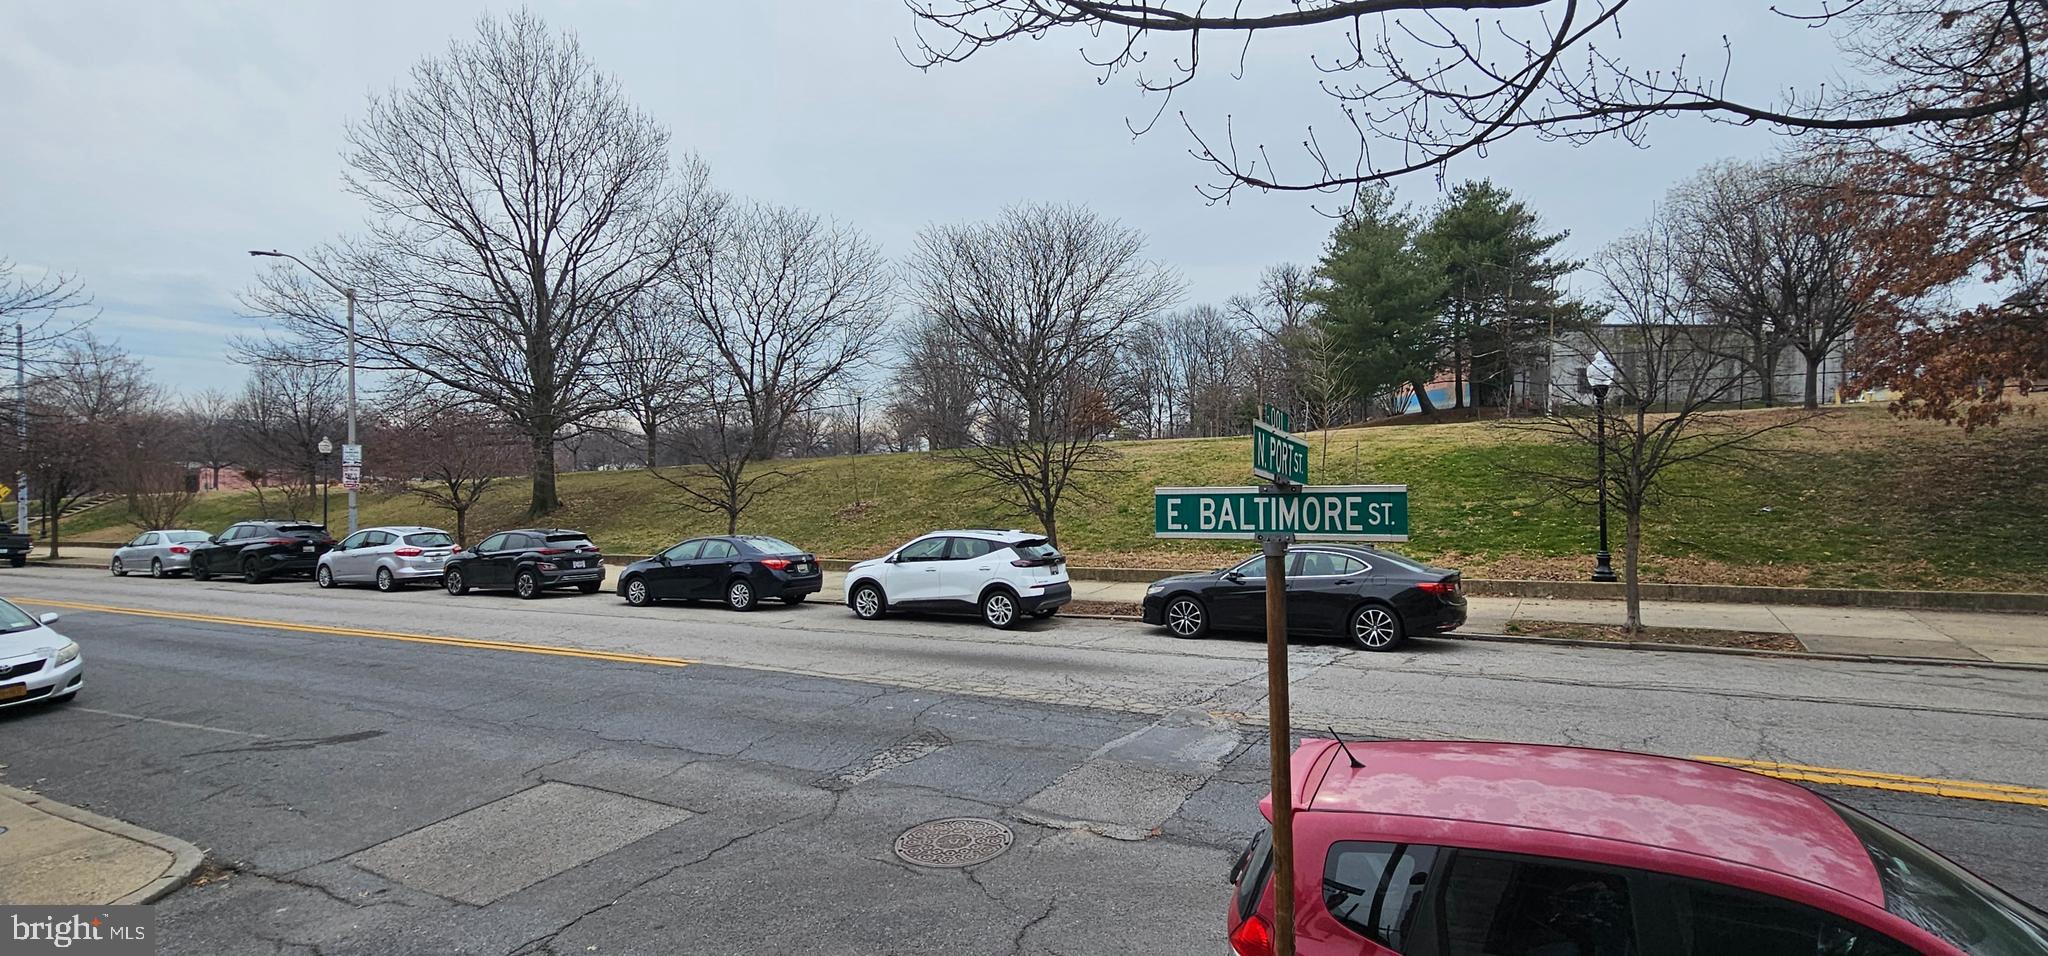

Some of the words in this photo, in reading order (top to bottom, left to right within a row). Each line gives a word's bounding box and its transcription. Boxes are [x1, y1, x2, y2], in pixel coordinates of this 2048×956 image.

[1258, 431, 1267, 468] N.
[1270, 436, 1294, 477] PORT
[1294, 452, 1304, 474] ST.
[1167, 498, 1188, 530] E.
[1199, 496, 1363, 531] BALTIMORE
[1368, 503, 1396, 525] ST.
